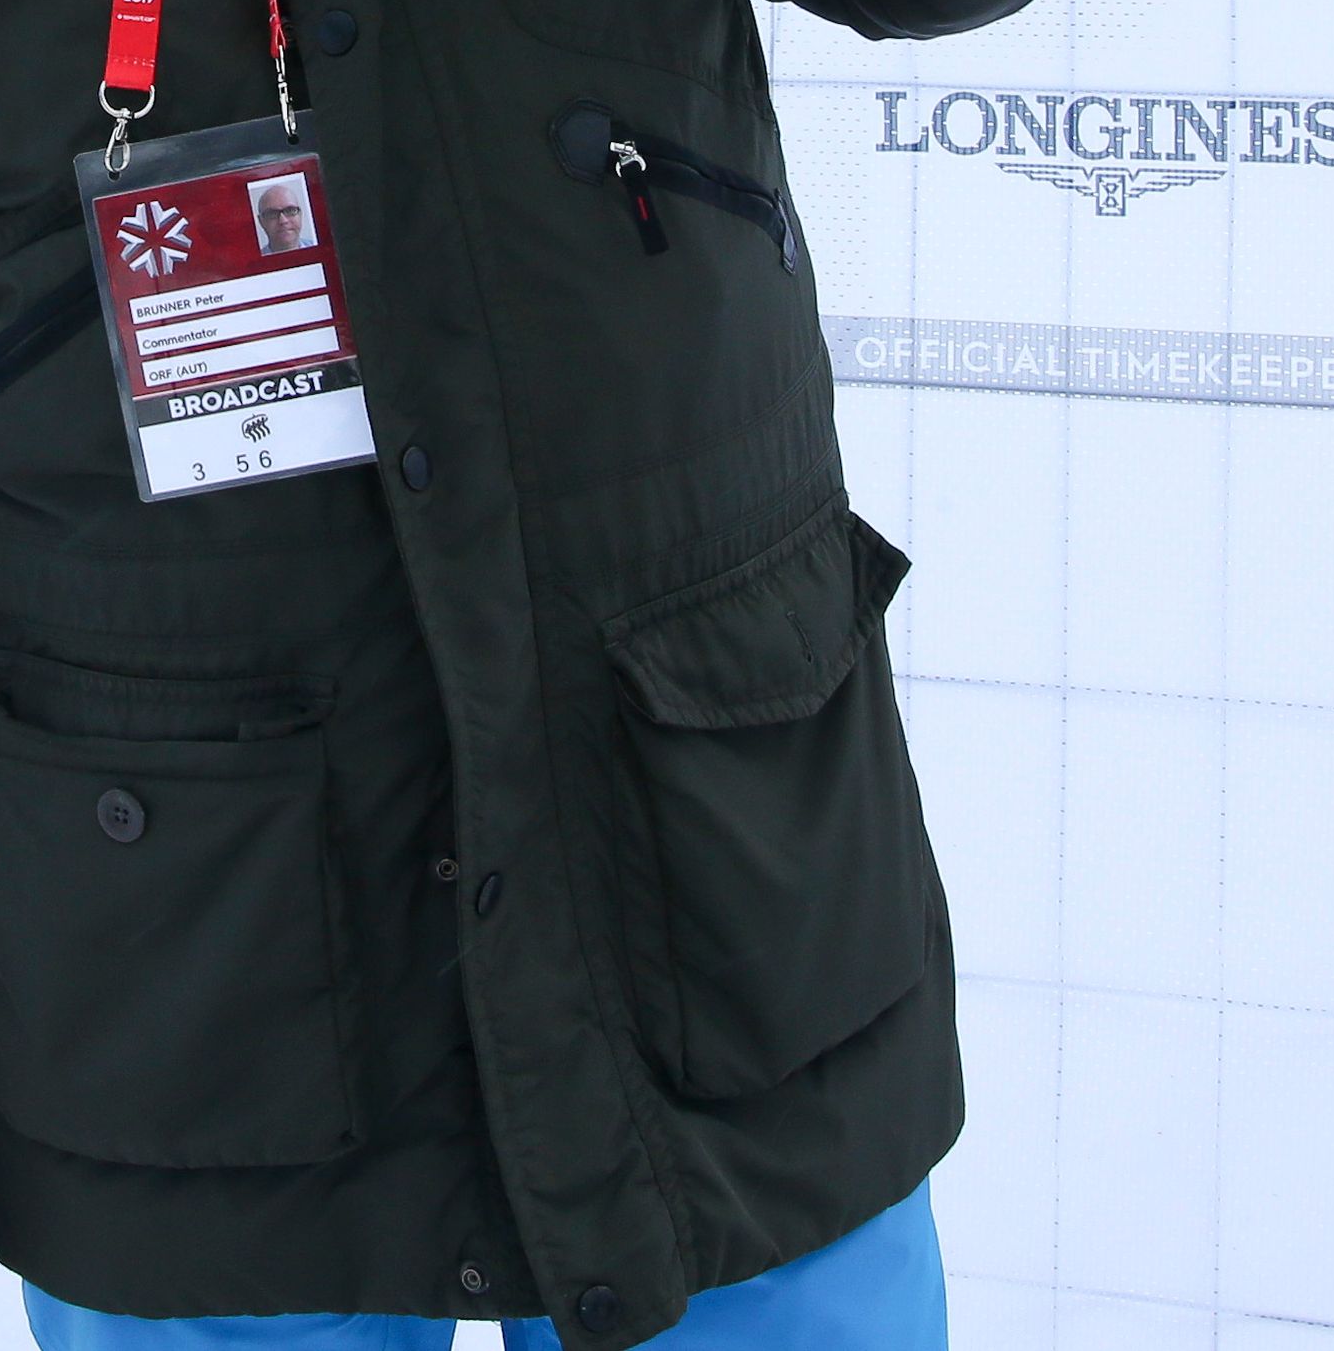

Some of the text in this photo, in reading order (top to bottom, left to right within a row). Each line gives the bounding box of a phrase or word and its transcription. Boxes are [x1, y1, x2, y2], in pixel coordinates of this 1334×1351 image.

[136, 292, 225, 318] BRUNNER Peter
[142, 327, 219, 350] Commentator
[853, 335, 1069, 378] OFFICIAL
[148, 361, 209, 382] ORF (AUT)
[168, 370, 324, 419] BROADCAST
[192, 462, 207, 482] 3
